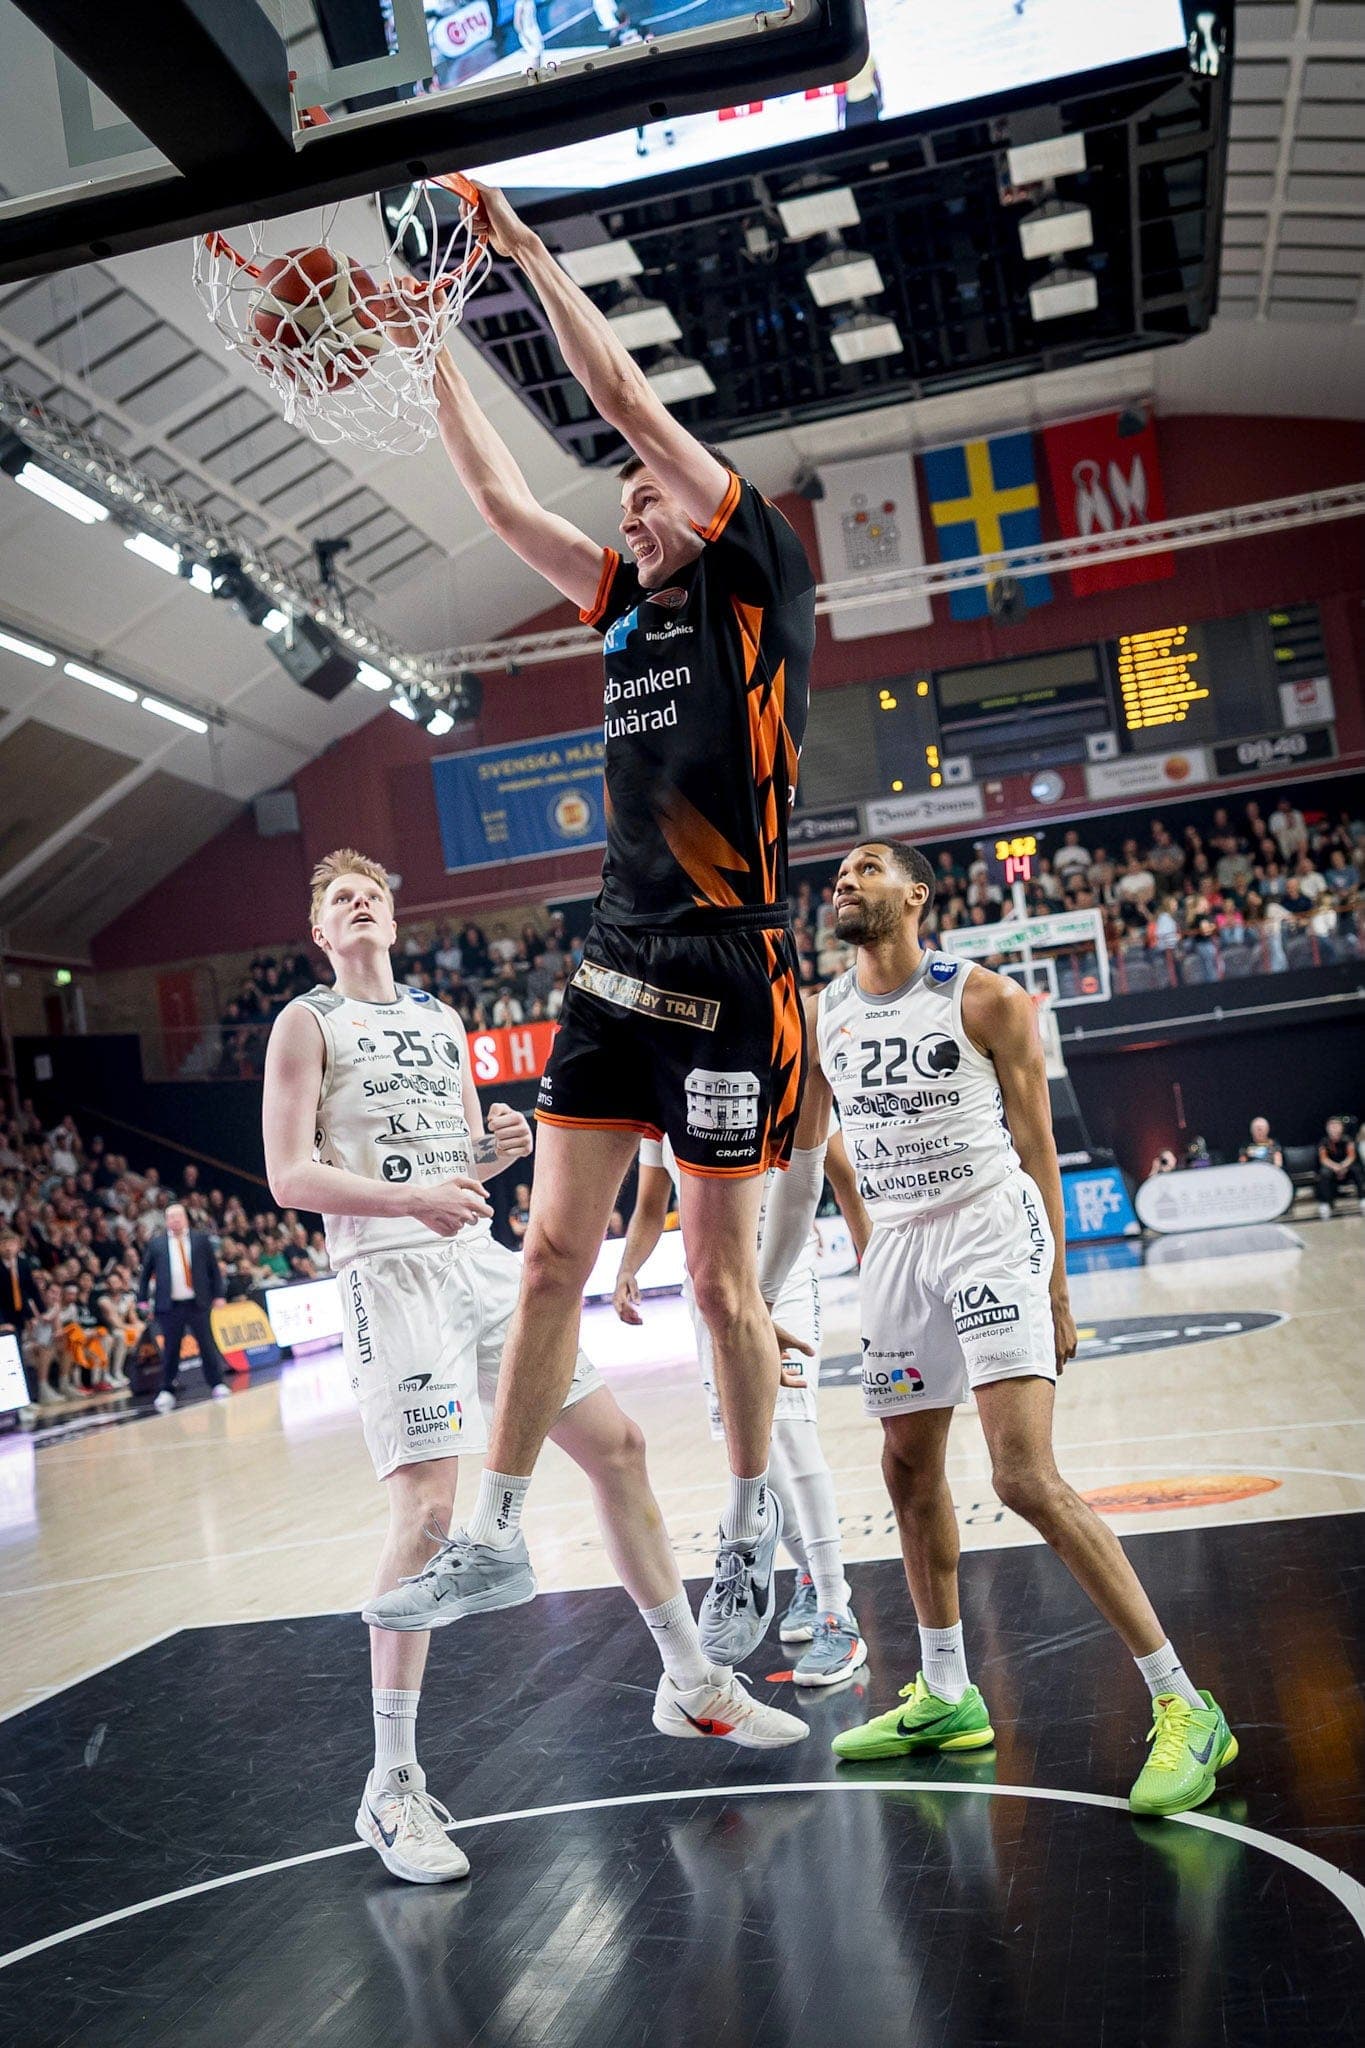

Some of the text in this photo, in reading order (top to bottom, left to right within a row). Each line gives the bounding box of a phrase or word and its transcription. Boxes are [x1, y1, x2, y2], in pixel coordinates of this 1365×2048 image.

[646, 625, 693, 641] UniGraphics
[1005, 855, 1031, 884] 14
[665, 1000, 697, 1018] TRÄ
[865, 1010, 900, 1020] stadium
[383, 1030, 433, 1066] 25
[861, 1037, 907, 1088] 22
[387, 1113, 411, 1136] K
[416, 1112, 432, 1131] A
[686, 1125, 756, 1142] Charmilla AB
[716, 1149, 749, 1157] CRAFT
[854, 1135, 950, 1161] K A project
[877, 1164, 974, 1192] LUNDBERGS
[958, 1284, 1001, 1313] ICA
[350, 1270, 373, 1364] stadium
[956, 1307, 1016, 1332] KVANTUM
[398, 1382, 418, 1393] Flyg
[403, 1404, 448, 1425] TELLO
[407, 1420, 450, 1437] GRUPPEN
[502, 1491, 513, 1520] CRAFT
